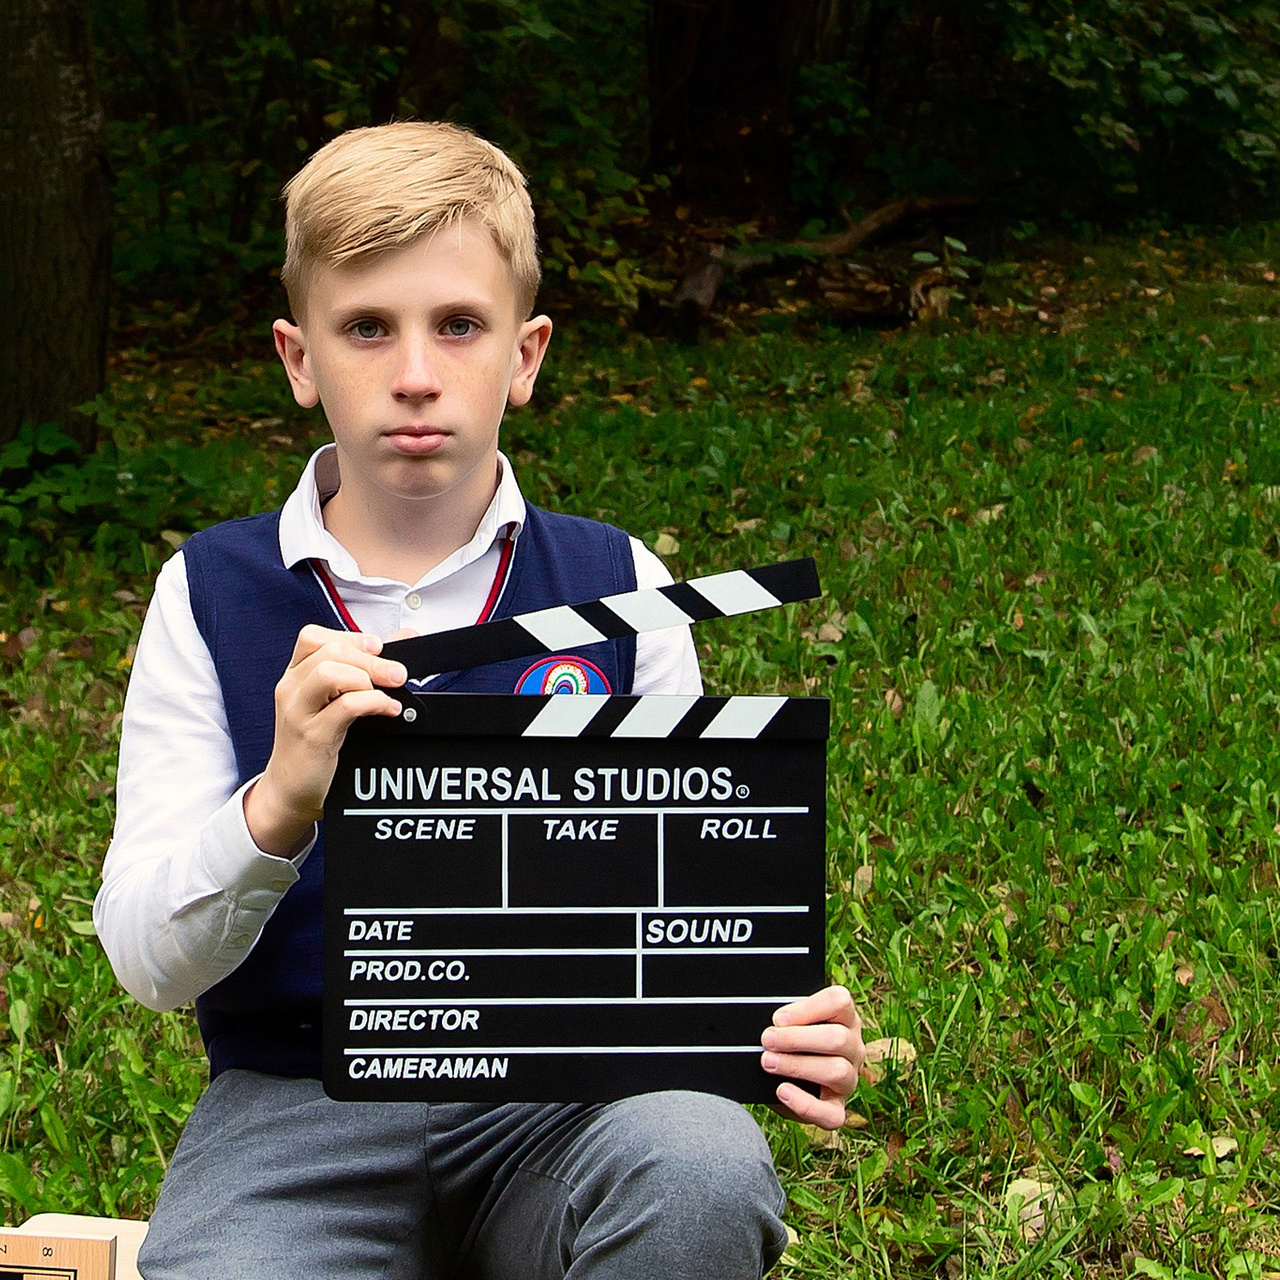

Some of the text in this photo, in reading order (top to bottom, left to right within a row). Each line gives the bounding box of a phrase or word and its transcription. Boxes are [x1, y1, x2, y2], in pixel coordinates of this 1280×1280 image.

[354, 766, 562, 802] UNIVERSAL
[374, 818, 778, 841] SCENE TAKE ROLL
[348, 920, 414, 941] DATE
[645, 918, 753, 943] SOUND
[349, 960, 470, 981] PROD.CO.
[349, 1008, 480, 1031] DIRECTOR
[348, 1057, 509, 1080] CAMERAMAN
[42, 1246, 54, 1257] 8
